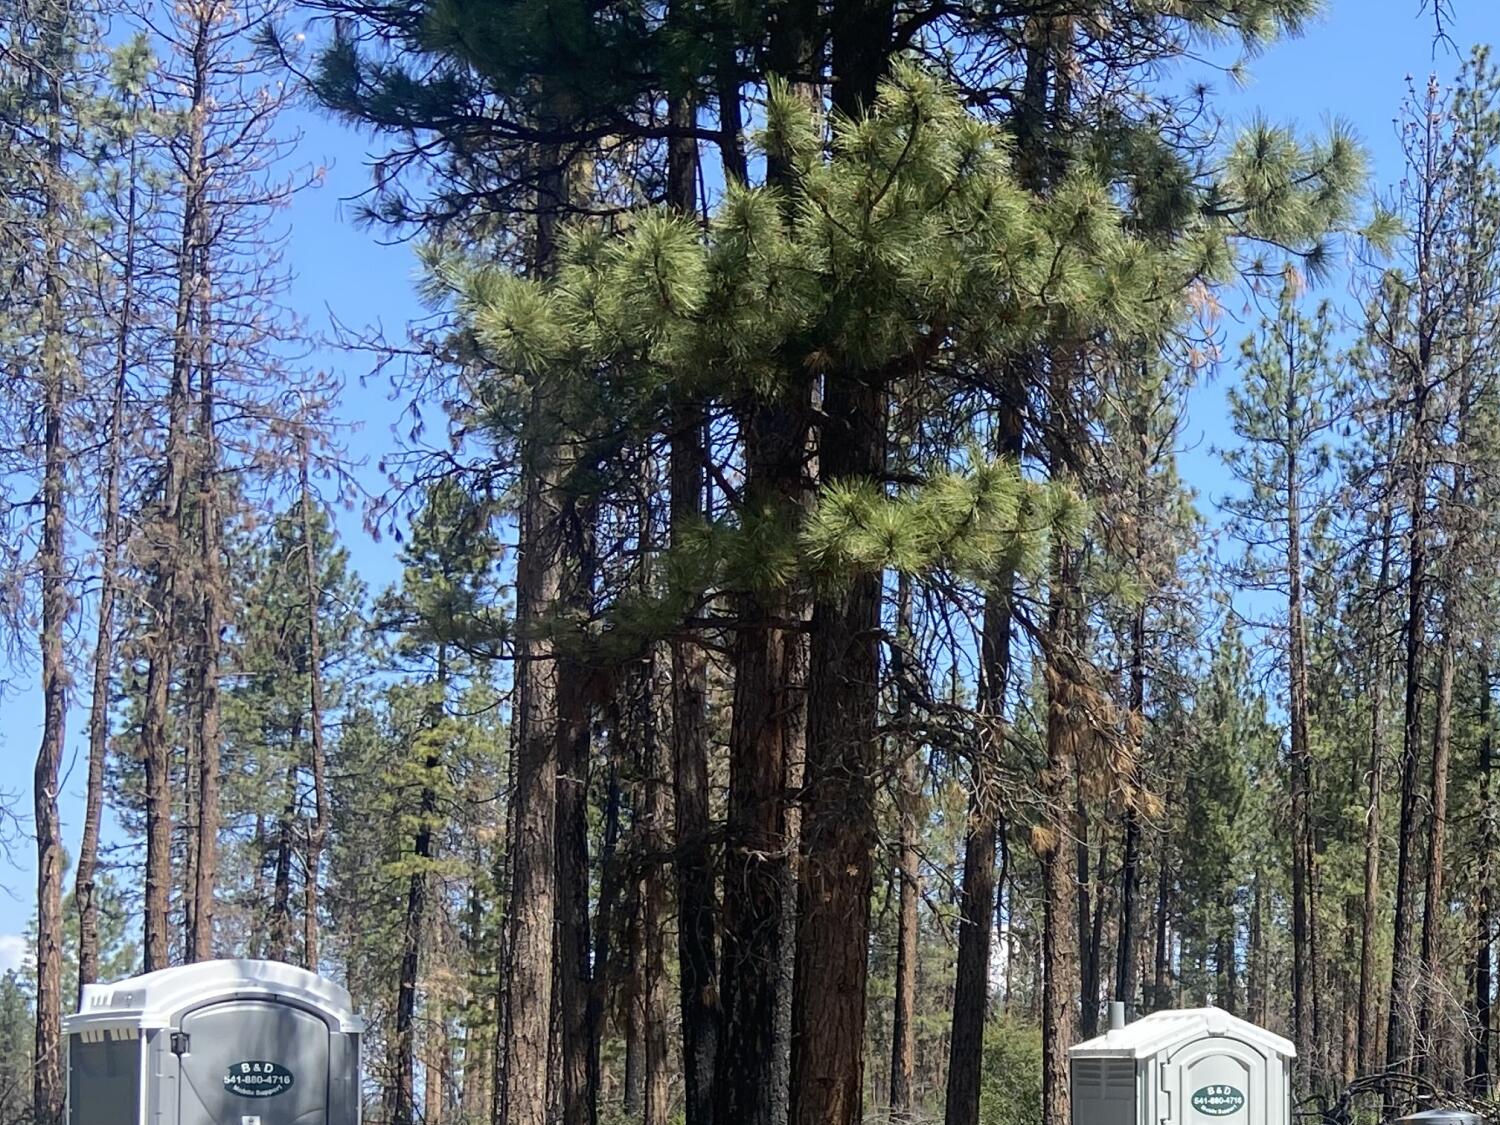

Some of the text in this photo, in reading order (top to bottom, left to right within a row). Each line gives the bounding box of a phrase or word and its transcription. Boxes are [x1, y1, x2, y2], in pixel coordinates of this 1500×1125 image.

[241, 1063, 274, 1073] B & D
[1208, 1086, 1215, 1095] B
[1224, 1086, 1231, 1095] D
